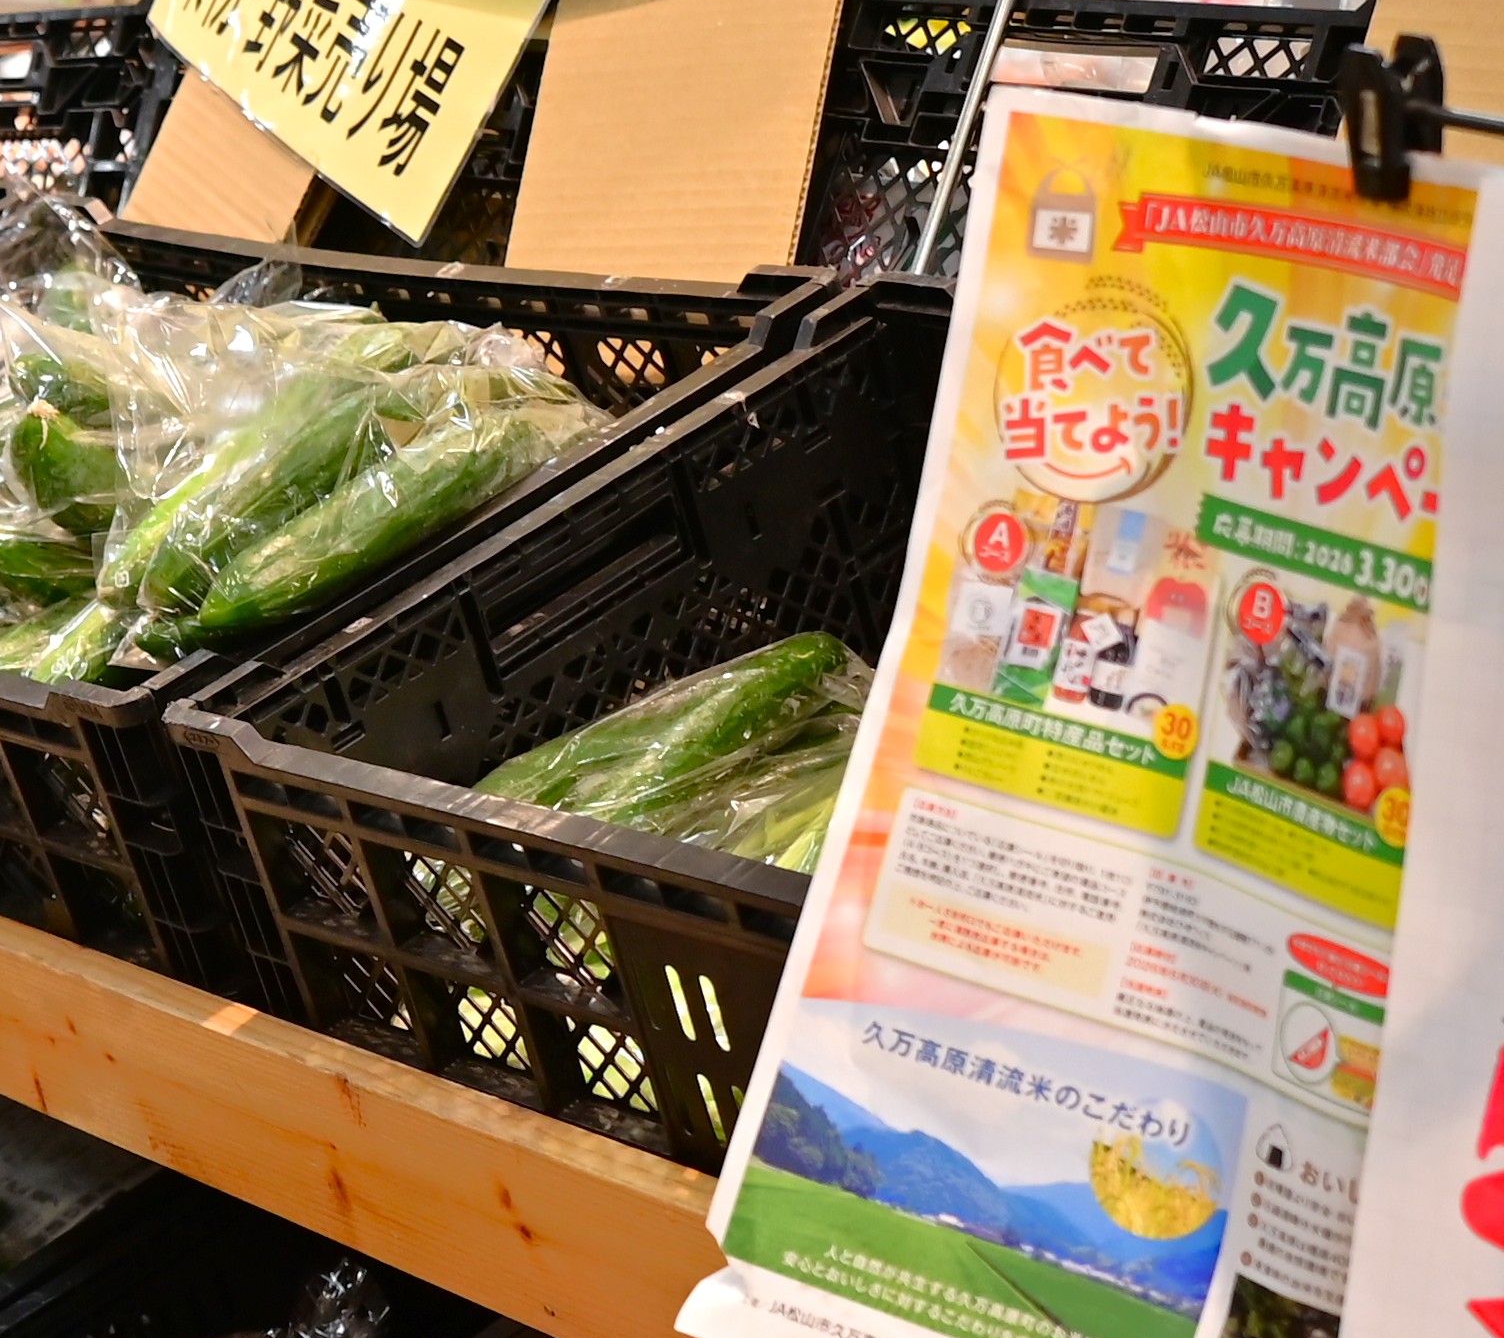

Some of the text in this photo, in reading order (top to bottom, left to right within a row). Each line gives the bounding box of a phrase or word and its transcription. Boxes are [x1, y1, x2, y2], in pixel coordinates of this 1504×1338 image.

[1049, 211, 1079, 245] 米
[1019, 320, 1157, 393] 食べて
[1206, 281, 1444, 432] 久万高原
[1002, 396, 1184, 461] 当てよう!
[988, 521, 1010, 546] A
[1251, 591, 1272, 617] B
[1160, 713, 1193, 740] 30
[861, 1018, 1194, 1148] 久万高原清流米のこだわり
